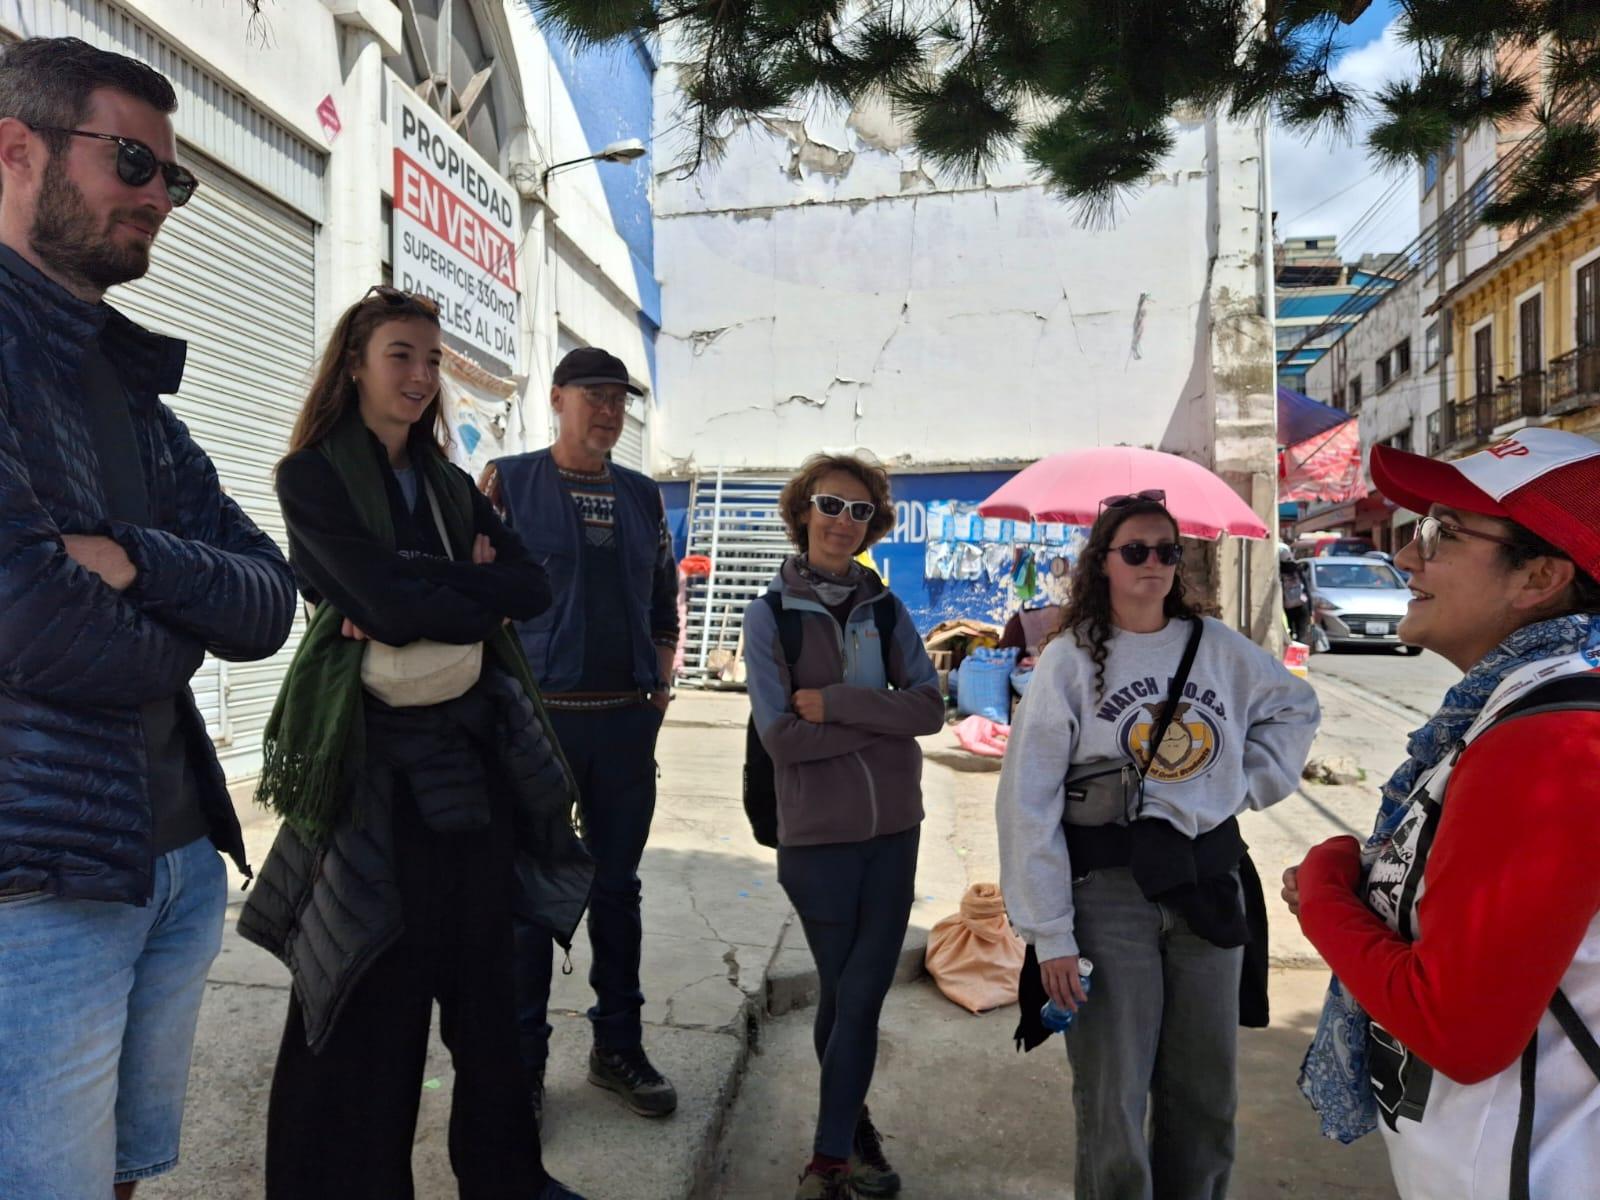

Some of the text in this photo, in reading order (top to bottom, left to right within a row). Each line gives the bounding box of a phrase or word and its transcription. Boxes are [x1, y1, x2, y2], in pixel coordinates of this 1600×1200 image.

[403, 104, 512, 228] PROPIEDAD
[403, 160, 516, 290] EN VENTA
[403, 231, 515, 325] SUPERFICIE 330m2
[475, 317, 491, 346] AL
[495, 326, 516, 359] DÍA
[1096, 677, 1159, 722] WATCH
